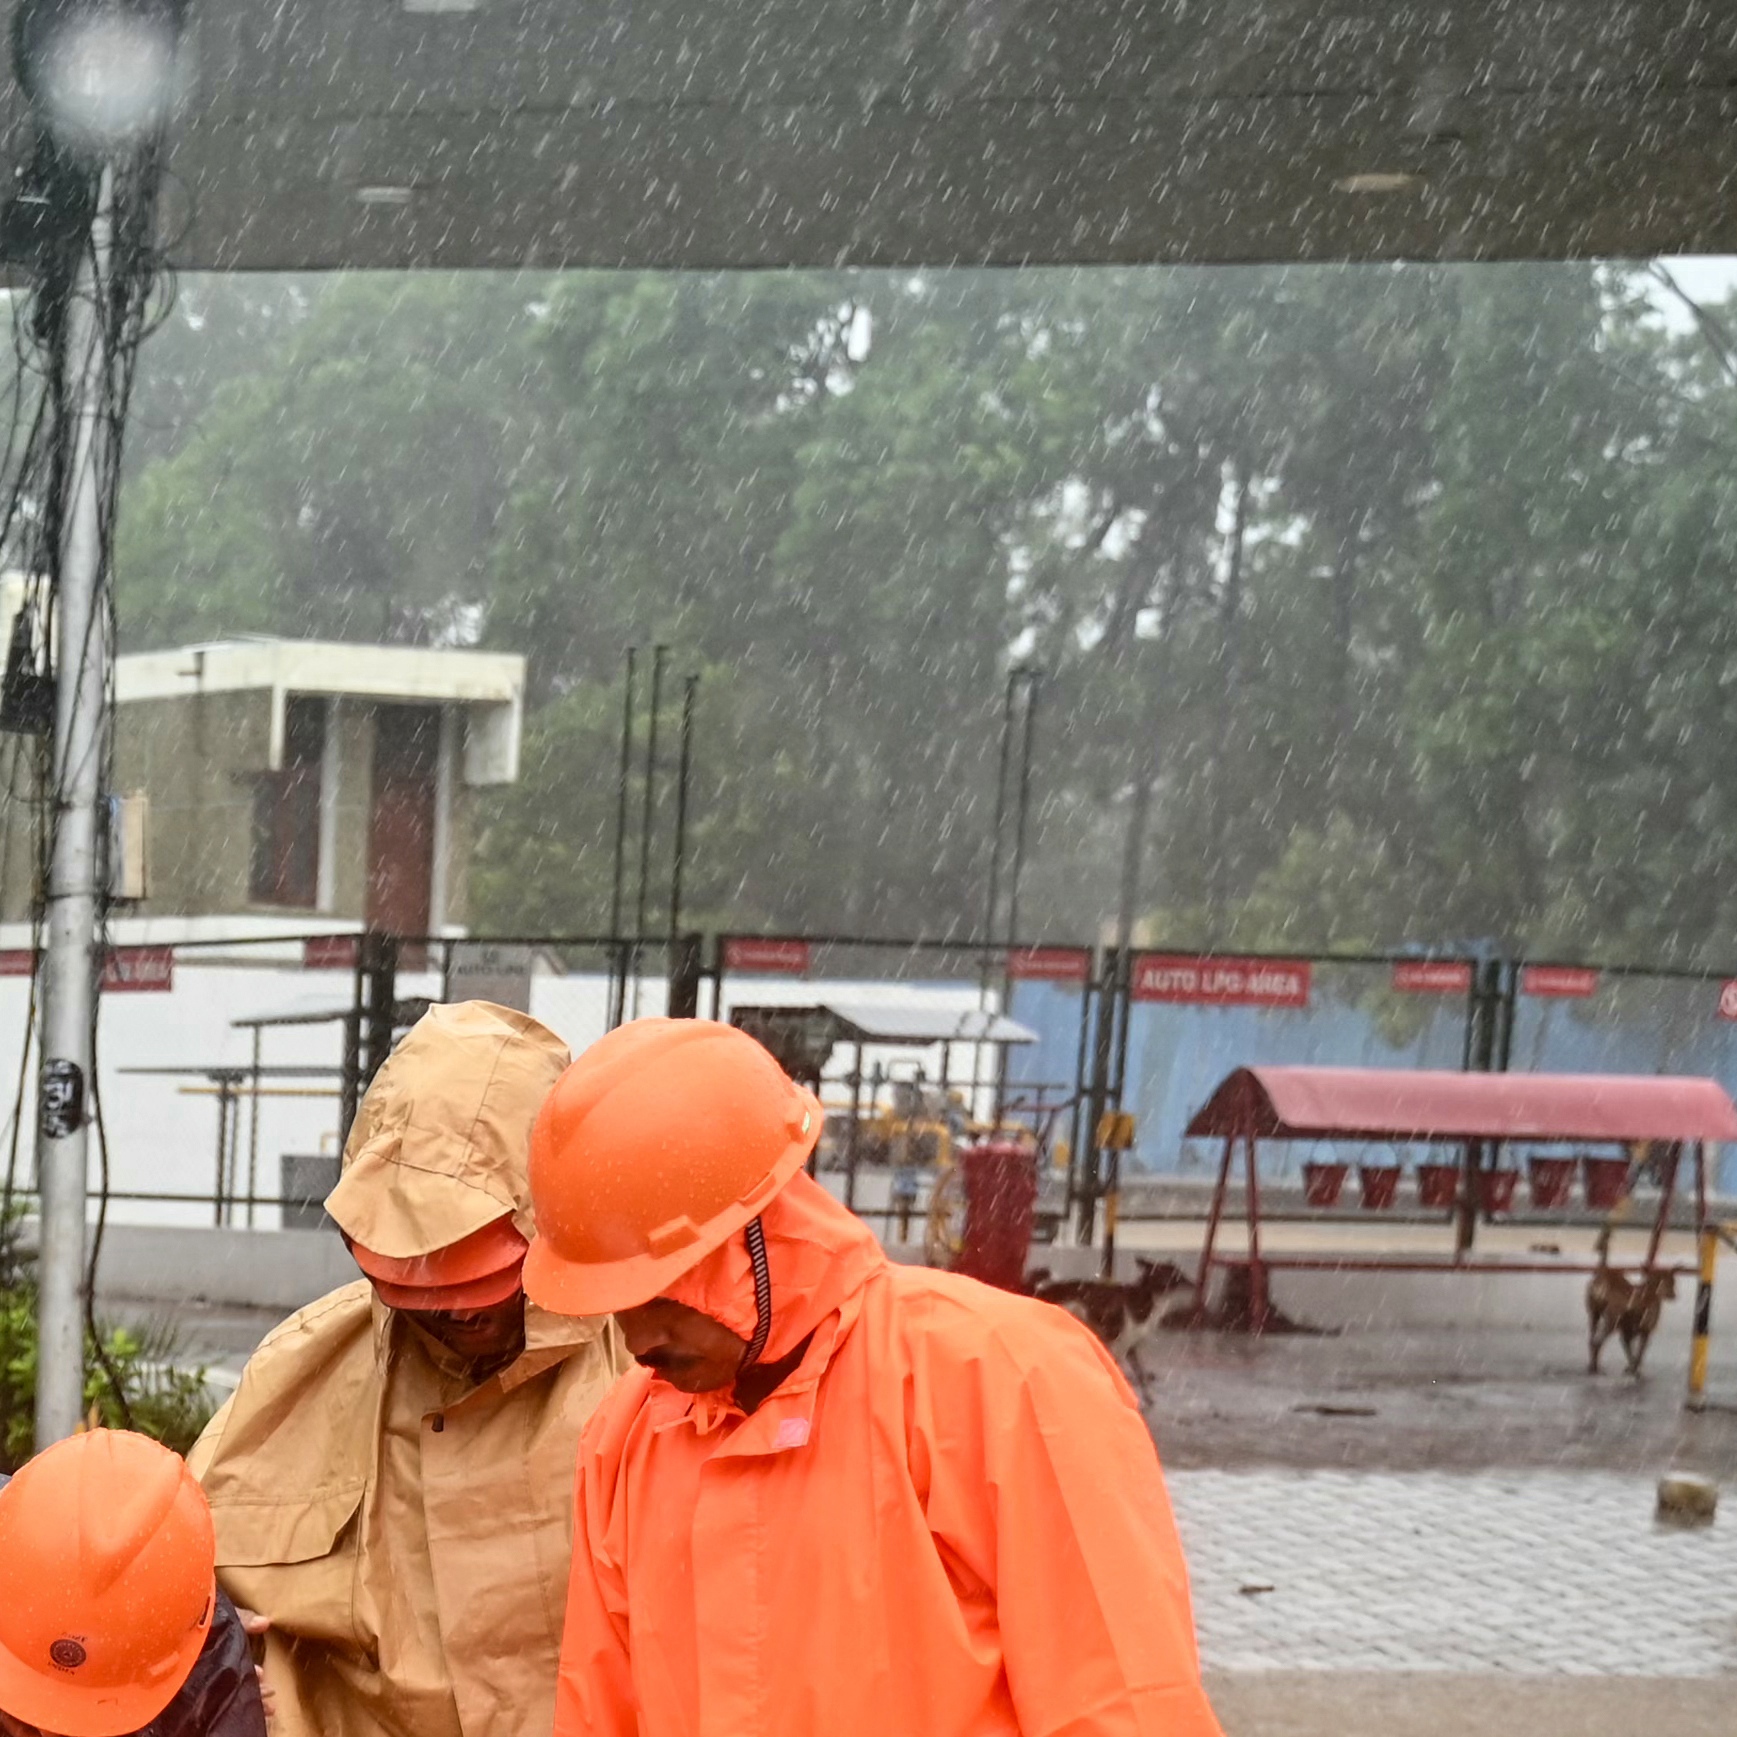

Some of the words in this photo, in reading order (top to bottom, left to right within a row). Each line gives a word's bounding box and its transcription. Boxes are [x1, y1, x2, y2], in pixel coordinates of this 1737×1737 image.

[1140, 968, 1197, 992] AUTO
[1200, 970, 1243, 993] LPG
[1245, 972, 1300, 995] AREA
